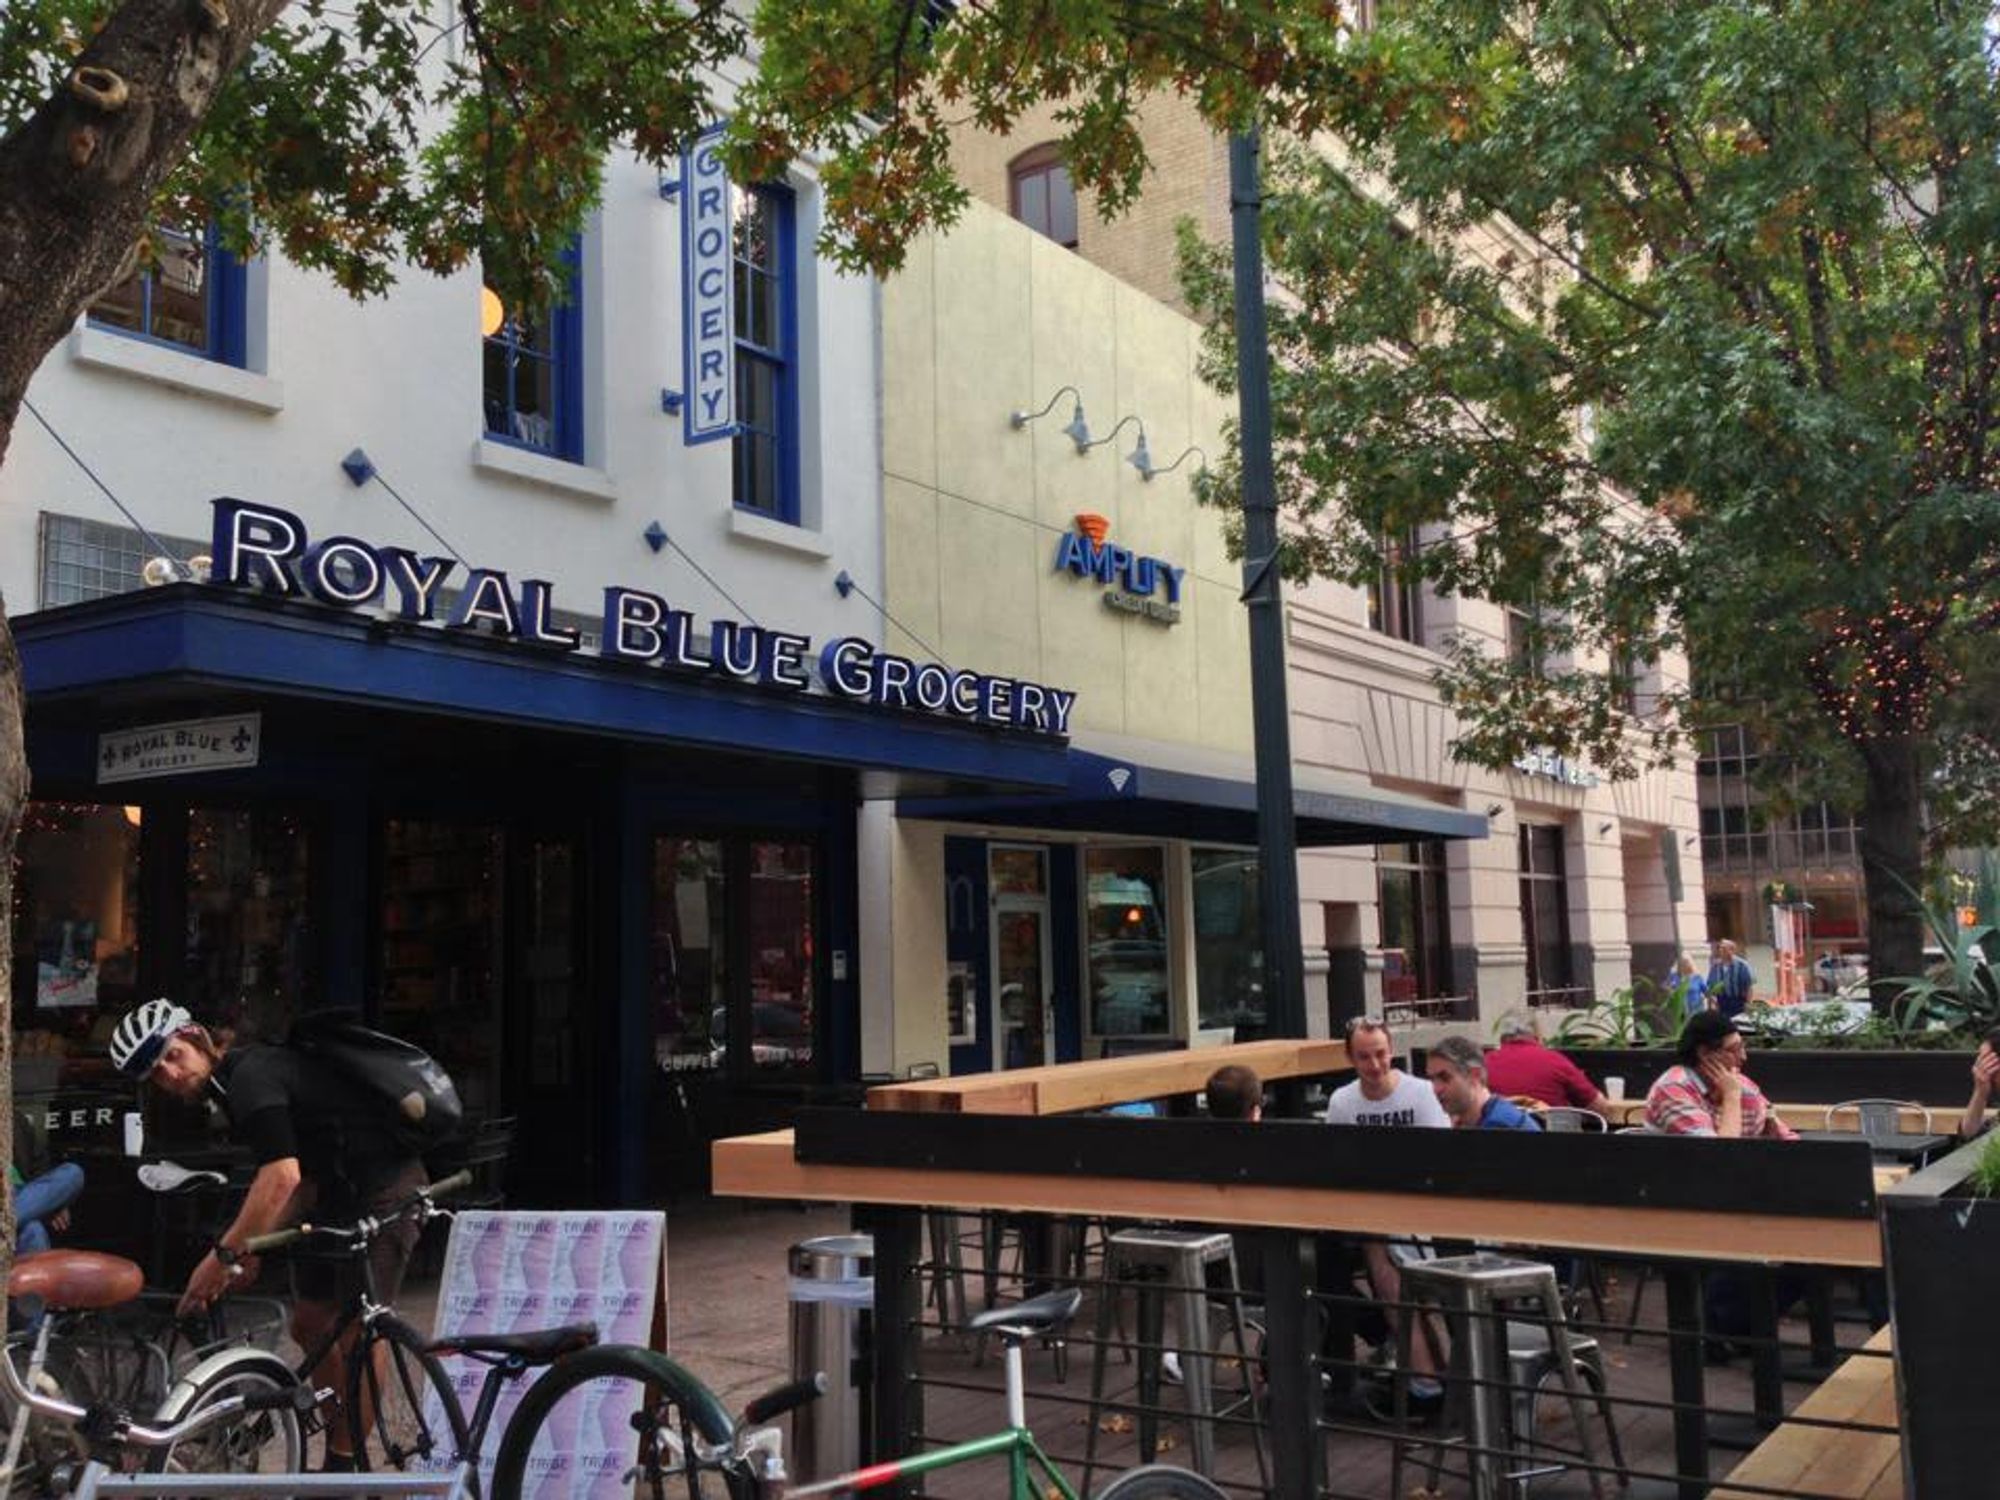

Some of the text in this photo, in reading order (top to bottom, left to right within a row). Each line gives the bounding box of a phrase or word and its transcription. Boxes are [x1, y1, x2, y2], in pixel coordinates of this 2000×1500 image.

[696, 149, 724, 420] GROCERY
[211, 497, 1077, 732] ROYAL BLUE GROCERY
[121, 730, 222, 763] ROYAL BLUE
